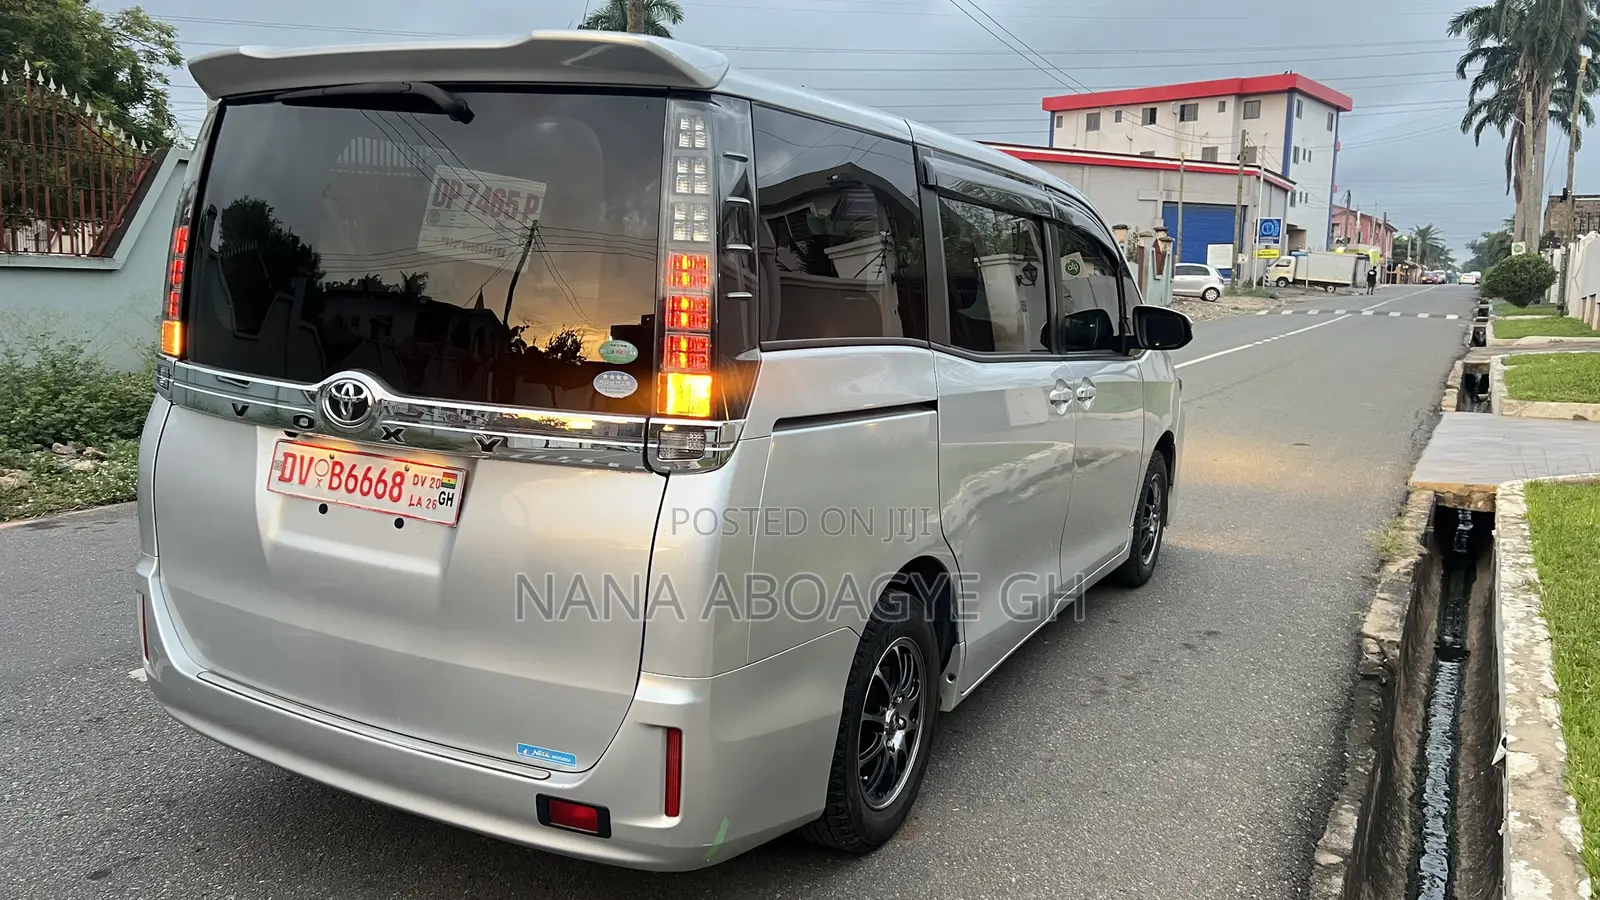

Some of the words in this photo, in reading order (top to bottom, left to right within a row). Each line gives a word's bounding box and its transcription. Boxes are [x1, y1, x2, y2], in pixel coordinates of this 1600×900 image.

[432, 178, 463, 209] DP
[522, 193, 540, 222] P
[231, 402, 504, 453] VOXY
[278, 451, 314, 485] DV
[327, 460, 405, 503] B6668
[412, 474, 428, 487] DV
[429, 476, 441, 489] 20
[408, 495, 423, 507] LA
[425, 497, 438, 510] 26
[438, 490, 454, 507] GH
